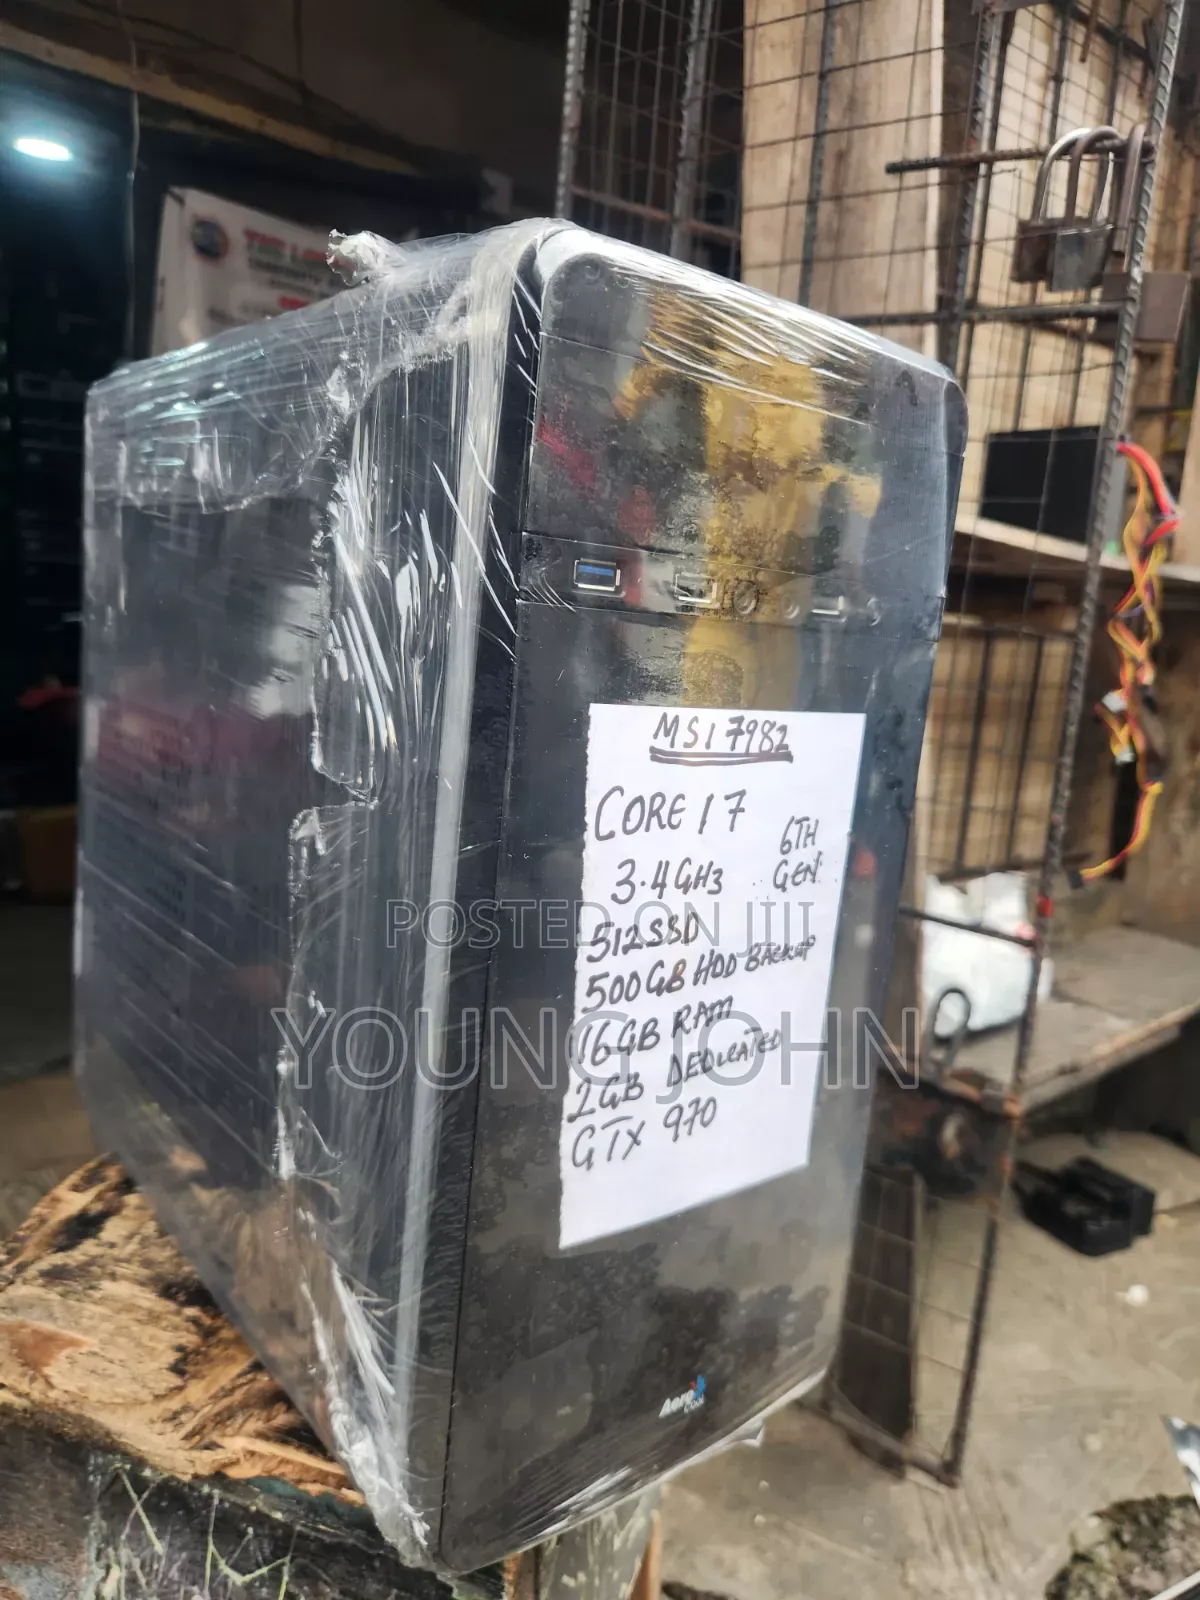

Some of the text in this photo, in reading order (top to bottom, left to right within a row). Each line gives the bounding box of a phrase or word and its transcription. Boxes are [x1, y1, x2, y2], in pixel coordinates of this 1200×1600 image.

[725, 714, 789, 754] 7982
[594, 786, 686, 841] CORE
[779, 816, 819, 855] 6TH
[774, 852, 821, 892] GEN
[672, 996, 733, 1038] RAM
[571, 1096, 718, 1171] GTX 970
